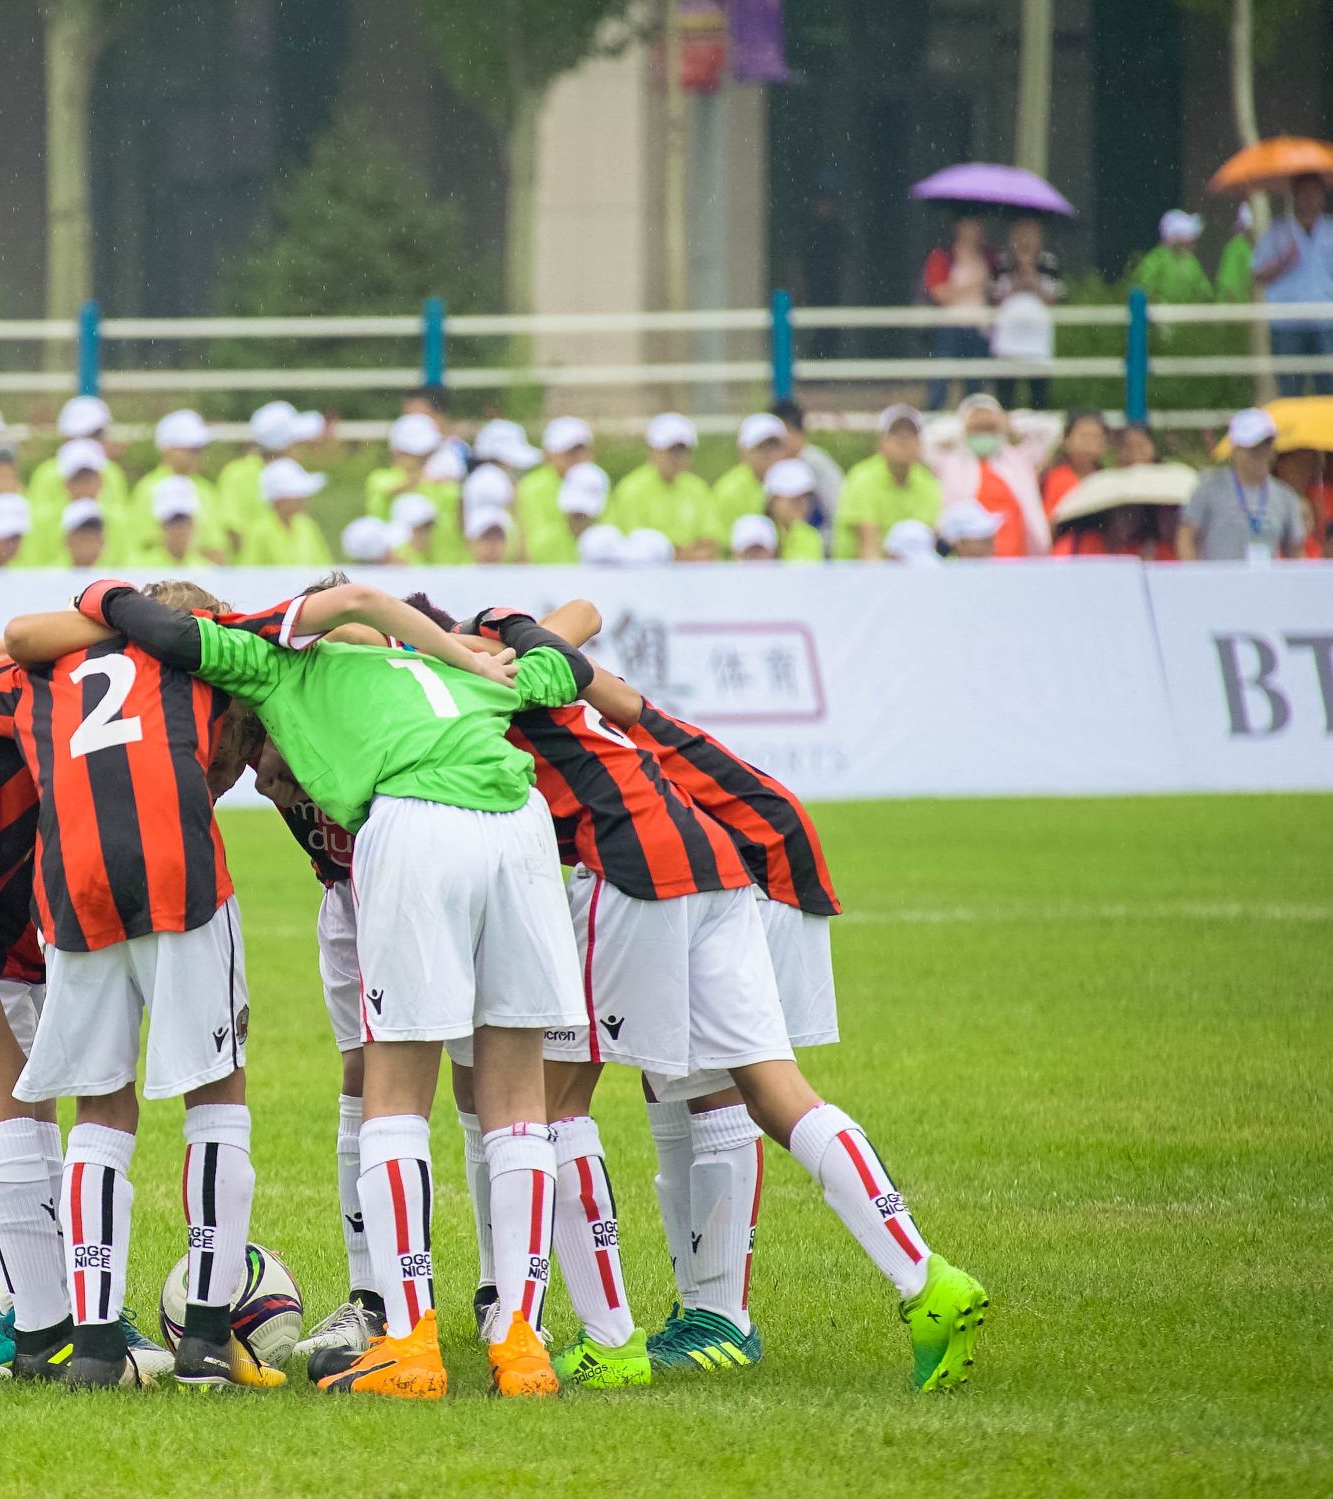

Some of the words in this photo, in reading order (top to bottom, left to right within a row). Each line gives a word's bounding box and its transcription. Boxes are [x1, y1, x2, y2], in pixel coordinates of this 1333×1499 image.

[386, 658, 462, 718] 1
[69, 653, 143, 759] 2
[308, 826, 352, 853] du
[75, 1245, 112, 1258] OGC
[75, 1256, 112, 1269] NICE
[571, 1363, 609, 1386] adidas
